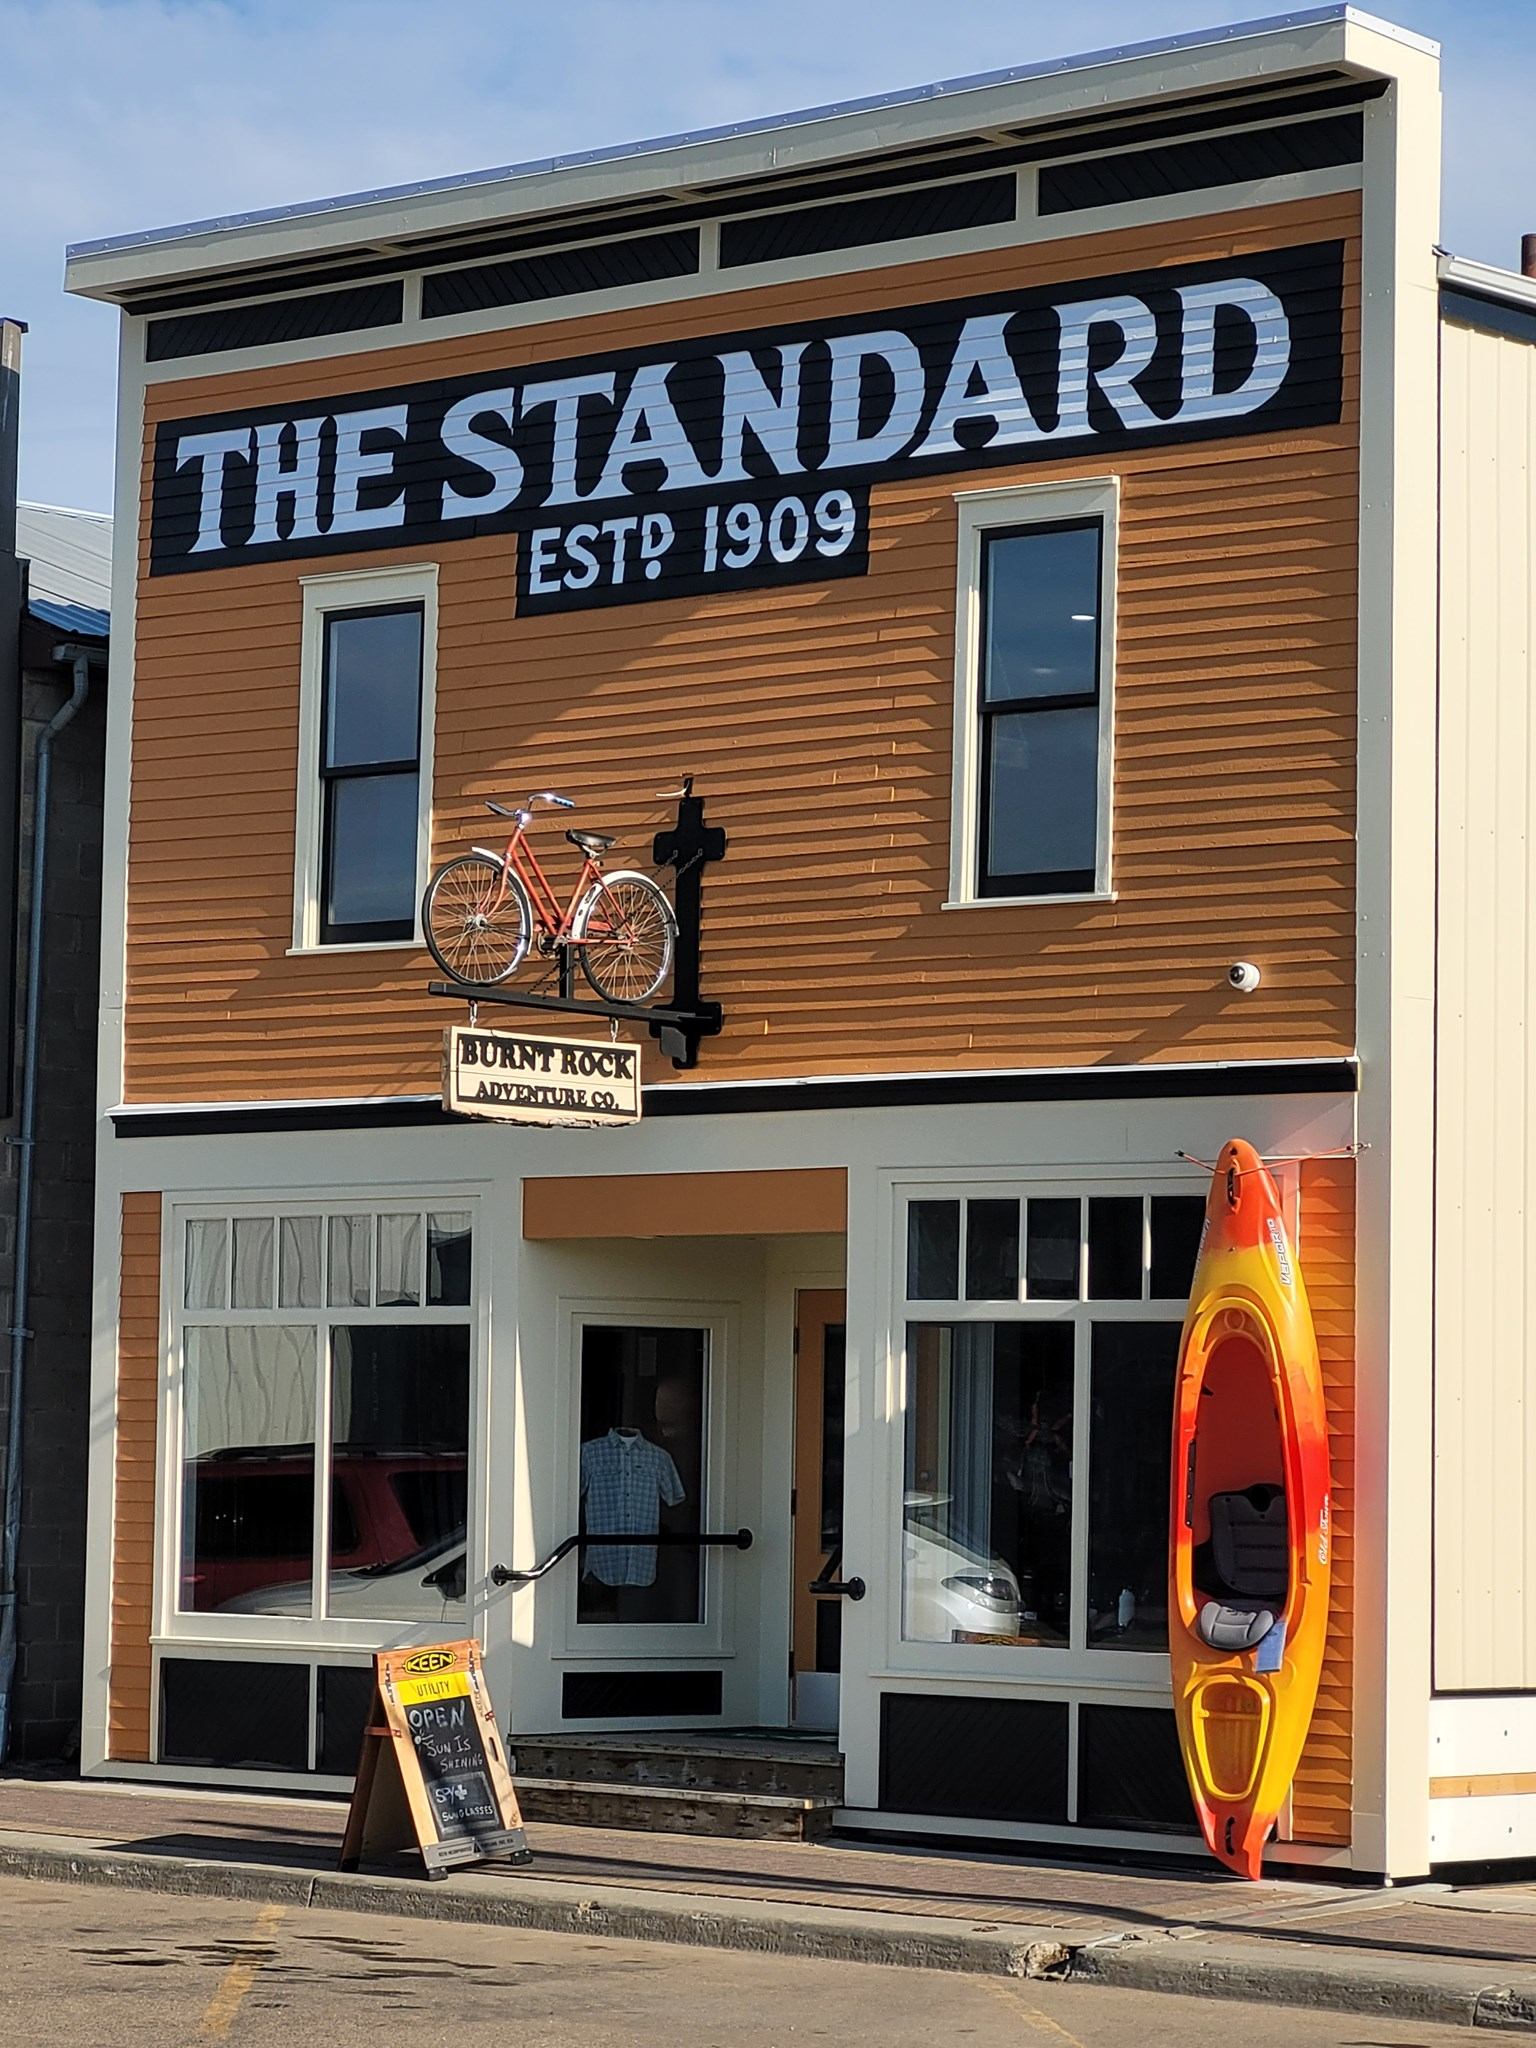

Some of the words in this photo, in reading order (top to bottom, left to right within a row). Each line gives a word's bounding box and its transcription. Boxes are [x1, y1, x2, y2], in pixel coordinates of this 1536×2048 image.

[175, 403, 409, 553] THE
[439, 277, 1291, 519] STANDARD
[703, 488, 856, 572] 1909
[460, 1038, 554, 1073] BURNT
[560, 1048, 634, 1080] ROCK
[476, 1080, 587, 1105] ADVENTURE
[590, 1091, 620, 1111] CO.
[406, 1653, 455, 1672] KEEN
[416, 1680, 450, 1697] UTILITY
[408, 1699, 466, 1729] OPEN
